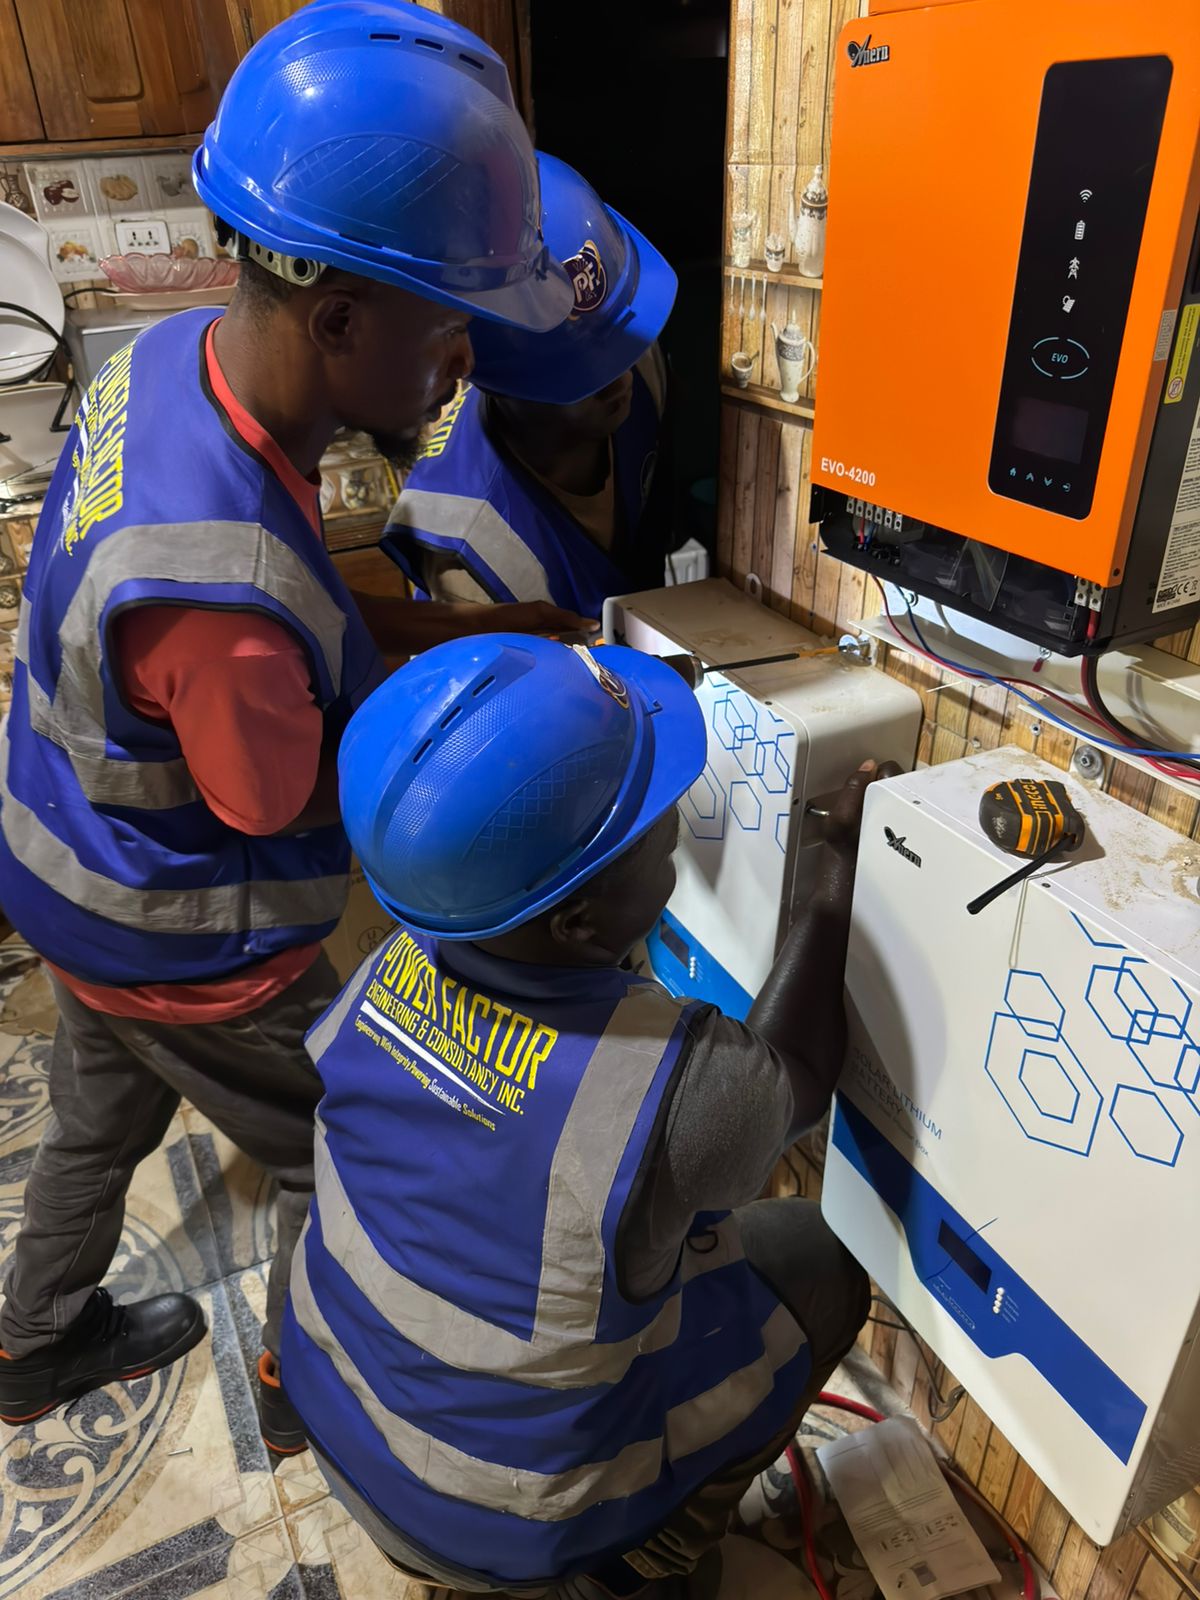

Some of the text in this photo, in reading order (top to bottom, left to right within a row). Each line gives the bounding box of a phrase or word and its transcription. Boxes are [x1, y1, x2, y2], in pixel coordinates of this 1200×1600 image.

[1051, 352, 1069, 364] EVO
[821, 457, 876, 487] EVO-4200
[376, 931, 559, 1090] POWER FACTOR
[366, 978, 525, 1115] ENGINEERING & CONSULTANCY INC.
[428, 1078, 462, 1112] Sustainable
[462, 1103, 496, 1132] Solutions
[893, 1085, 942, 1140] LITHIUM
